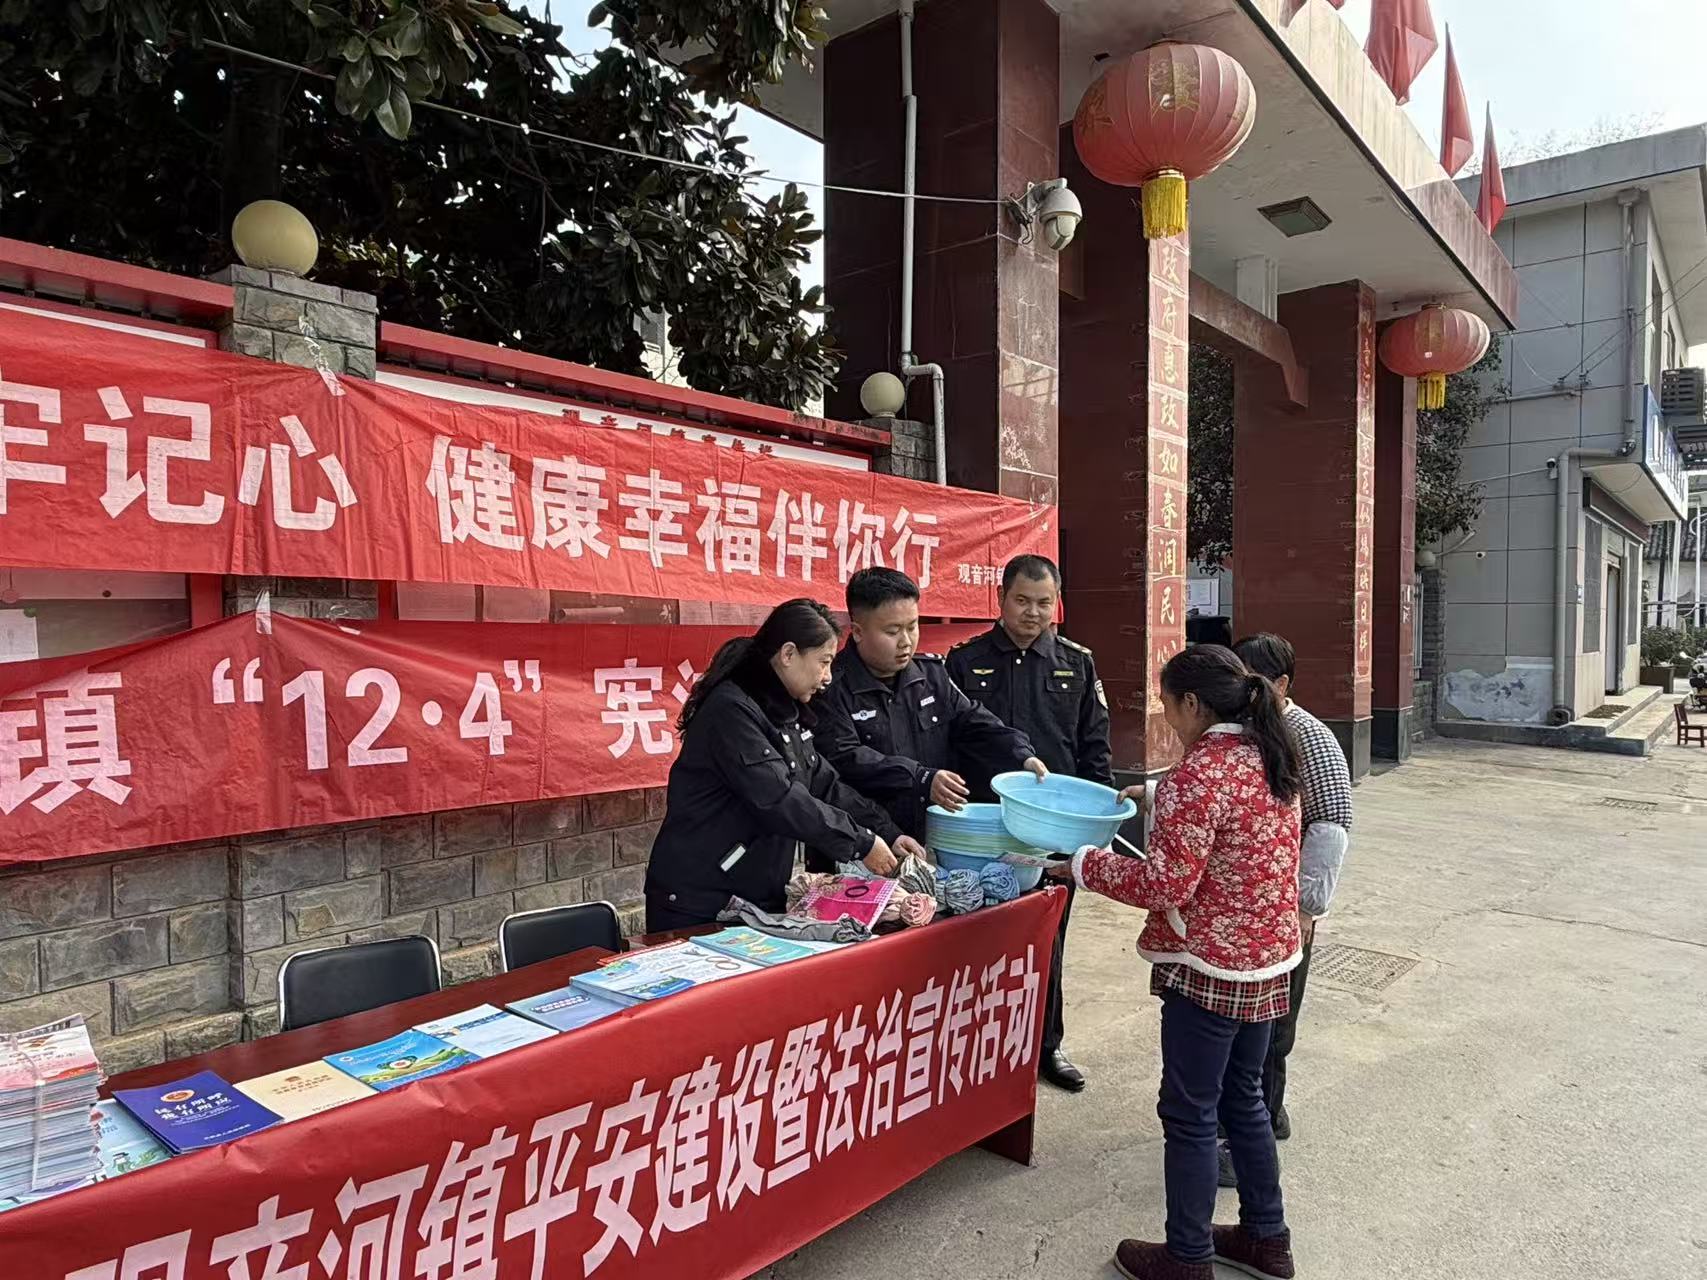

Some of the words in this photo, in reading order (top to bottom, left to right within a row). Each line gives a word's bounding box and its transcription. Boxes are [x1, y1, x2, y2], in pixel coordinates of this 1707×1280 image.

[424, 434, 941, 590] 健康幸福伴你行
[65, 944, 1041, 1280] 河镇平安建设暨法治宣传活动
